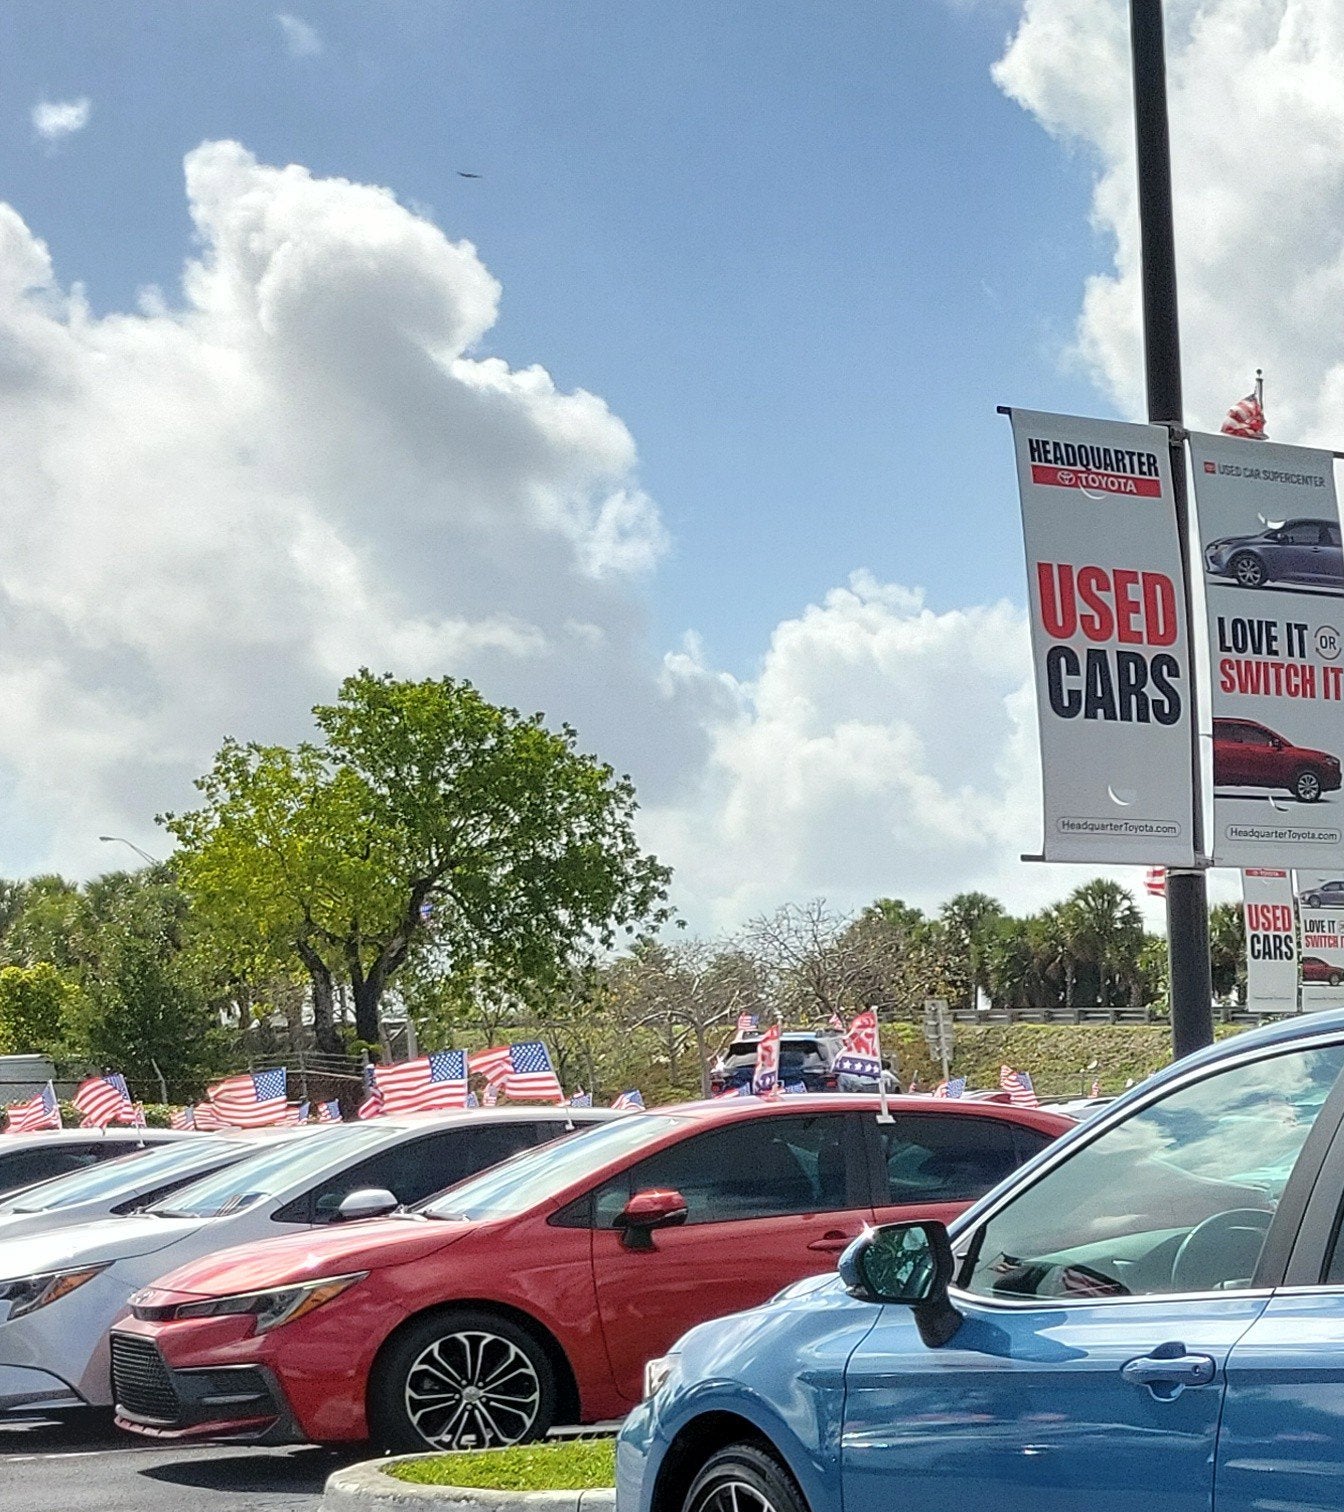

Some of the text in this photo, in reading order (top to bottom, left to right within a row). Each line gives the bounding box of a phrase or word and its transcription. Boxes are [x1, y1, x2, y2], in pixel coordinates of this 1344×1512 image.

[1028, 438, 1160, 477] HEADQUARTER
[1078, 473, 1137, 493] TOYOTA
[1219, 464, 1326, 488] USED CAR SUPERCENTER
[1037, 562, 1178, 647] USED
[1217, 617, 1337, 658] LOVE IT OR
[1046, 645, 1182, 726] CARS
[1219, 658, 1344, 700] SWITCH IT
[1061, 819, 1177, 834] HeadquarterToyota.com
[1230, 827, 1338, 841] HeadquarterToyota.com
[1247, 904, 1292, 933] USED
[1304, 919, 1325, 933] LOVE
[1327, 920, 1336, 934] IT
[1250, 933, 1294, 961] CARS
[1305, 934, 1339, 949] SWITCH
